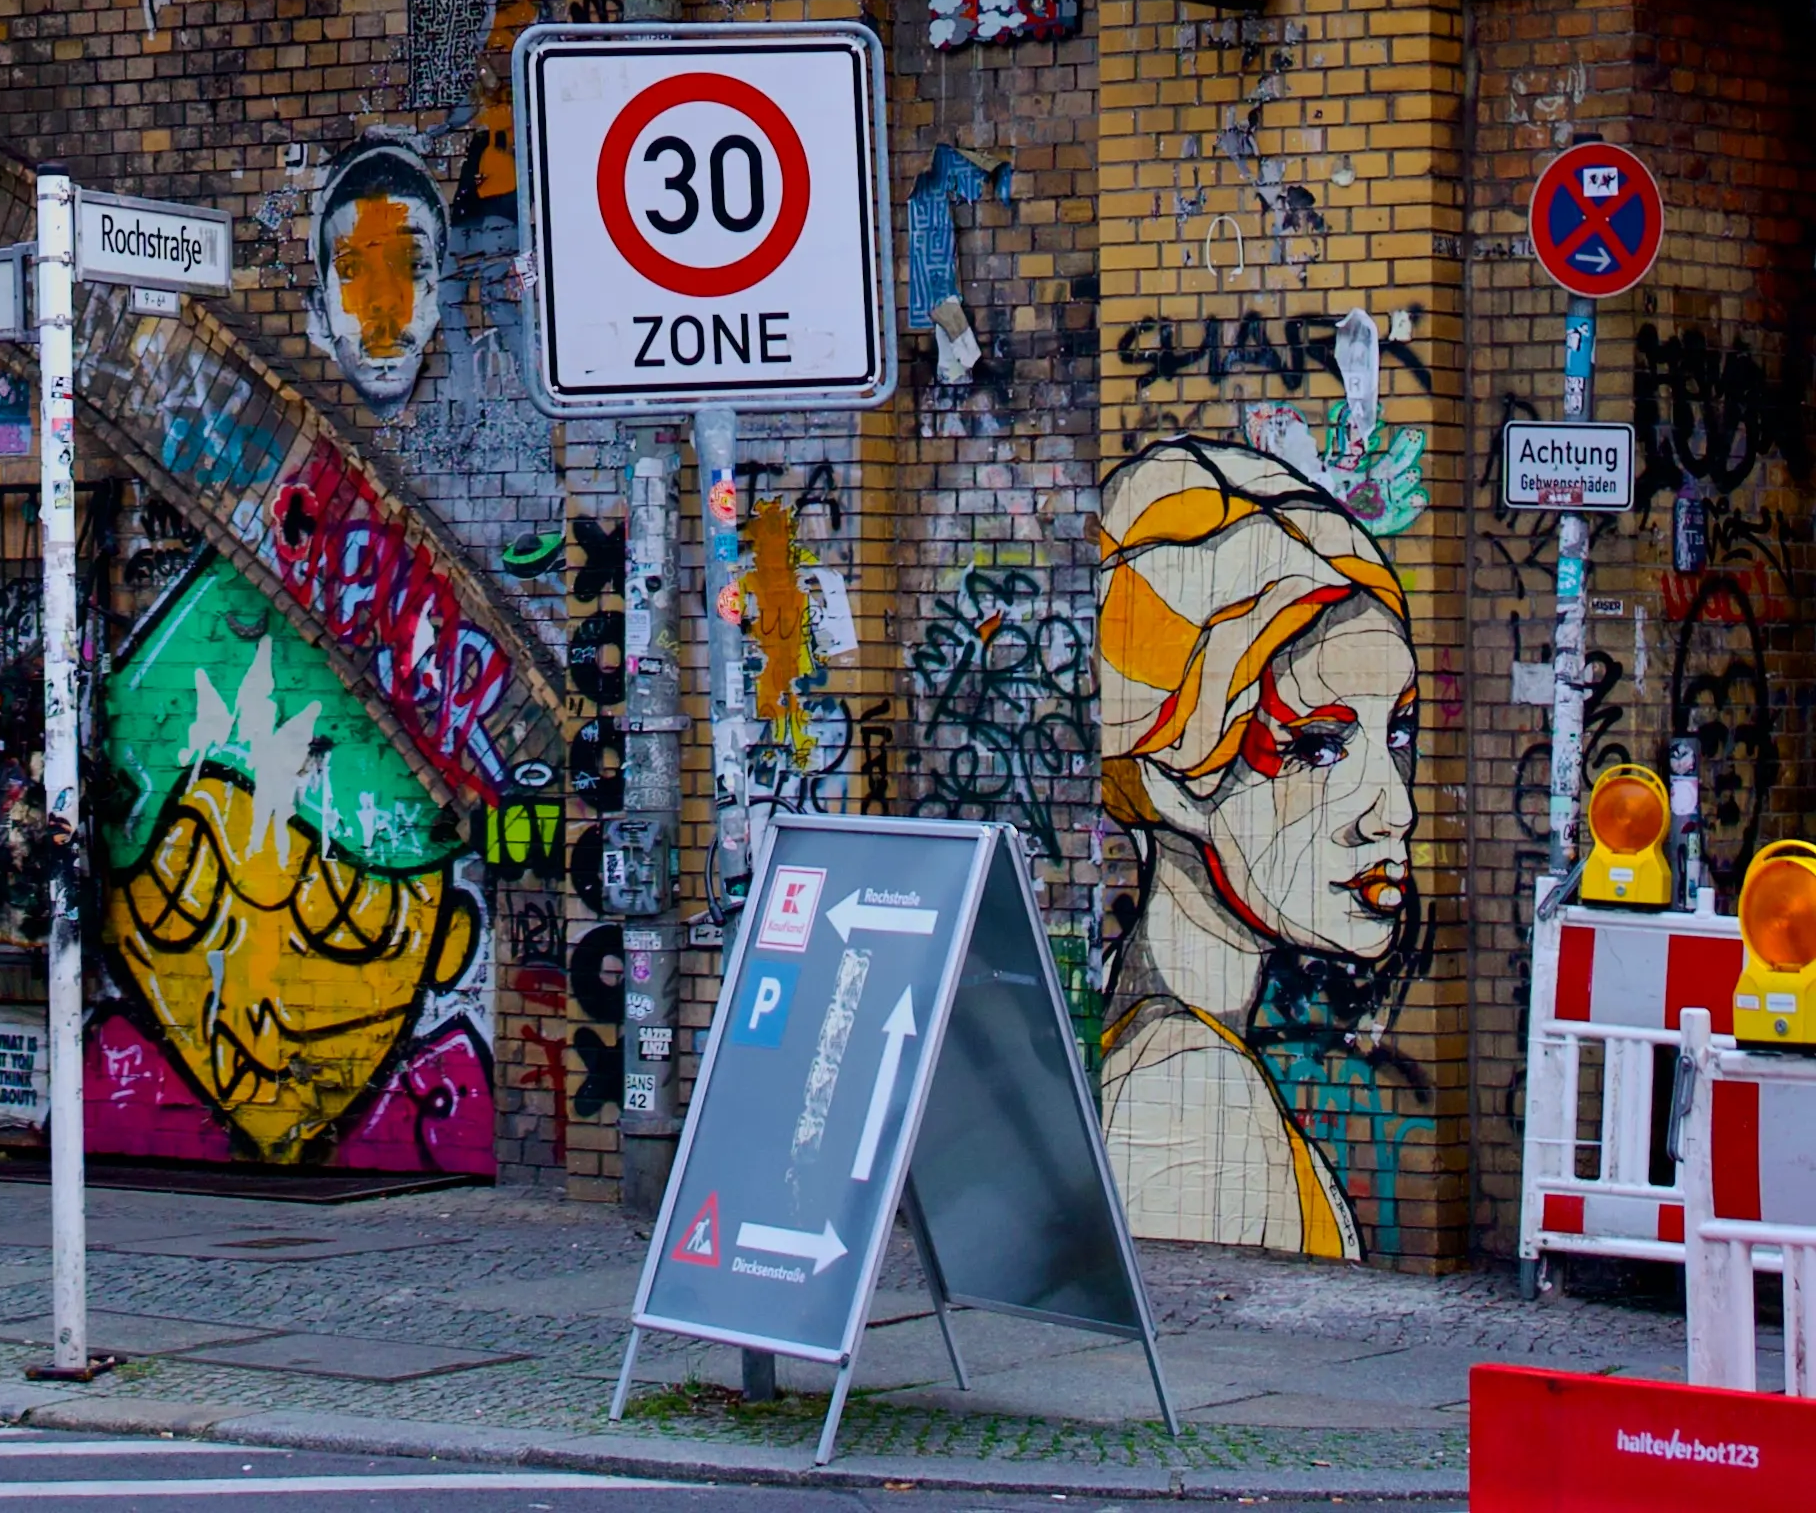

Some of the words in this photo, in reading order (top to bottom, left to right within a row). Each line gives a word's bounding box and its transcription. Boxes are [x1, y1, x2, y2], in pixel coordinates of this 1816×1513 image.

[644, 135, 764, 234] 30
[101, 214, 202, 272] Rochstraße
[633, 312, 792, 367] ZONE
[1519, 438, 1618, 472] Achtung
[864, 888, 921, 907] Rochstraße
[767, 920, 806, 935] Kaufland
[748, 977, 781, 1029] P
[11, 1053, 34, 1070] YOU
[629, 1093, 647, 1109] 42
[731, 1256, 806, 1283] Dircksenstraße
